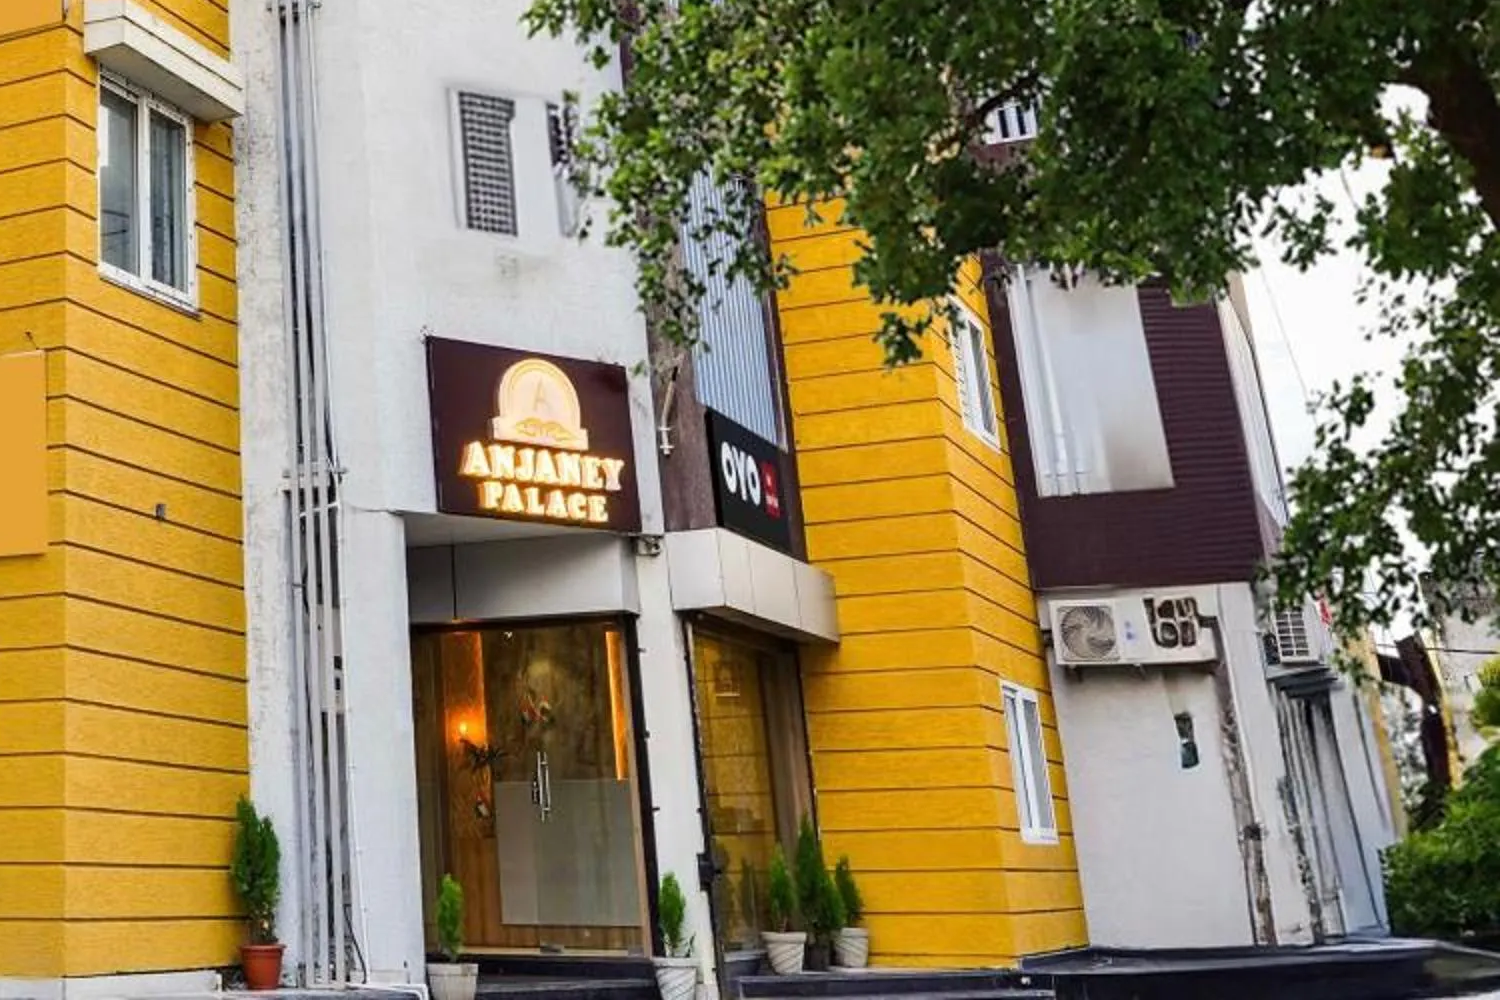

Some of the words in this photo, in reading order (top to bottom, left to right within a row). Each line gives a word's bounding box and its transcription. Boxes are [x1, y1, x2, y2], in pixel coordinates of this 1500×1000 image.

[458, 441, 624, 491] ANJANEY
[721, 441, 761, 506] OYO
[478, 481, 608, 522] PALACE
